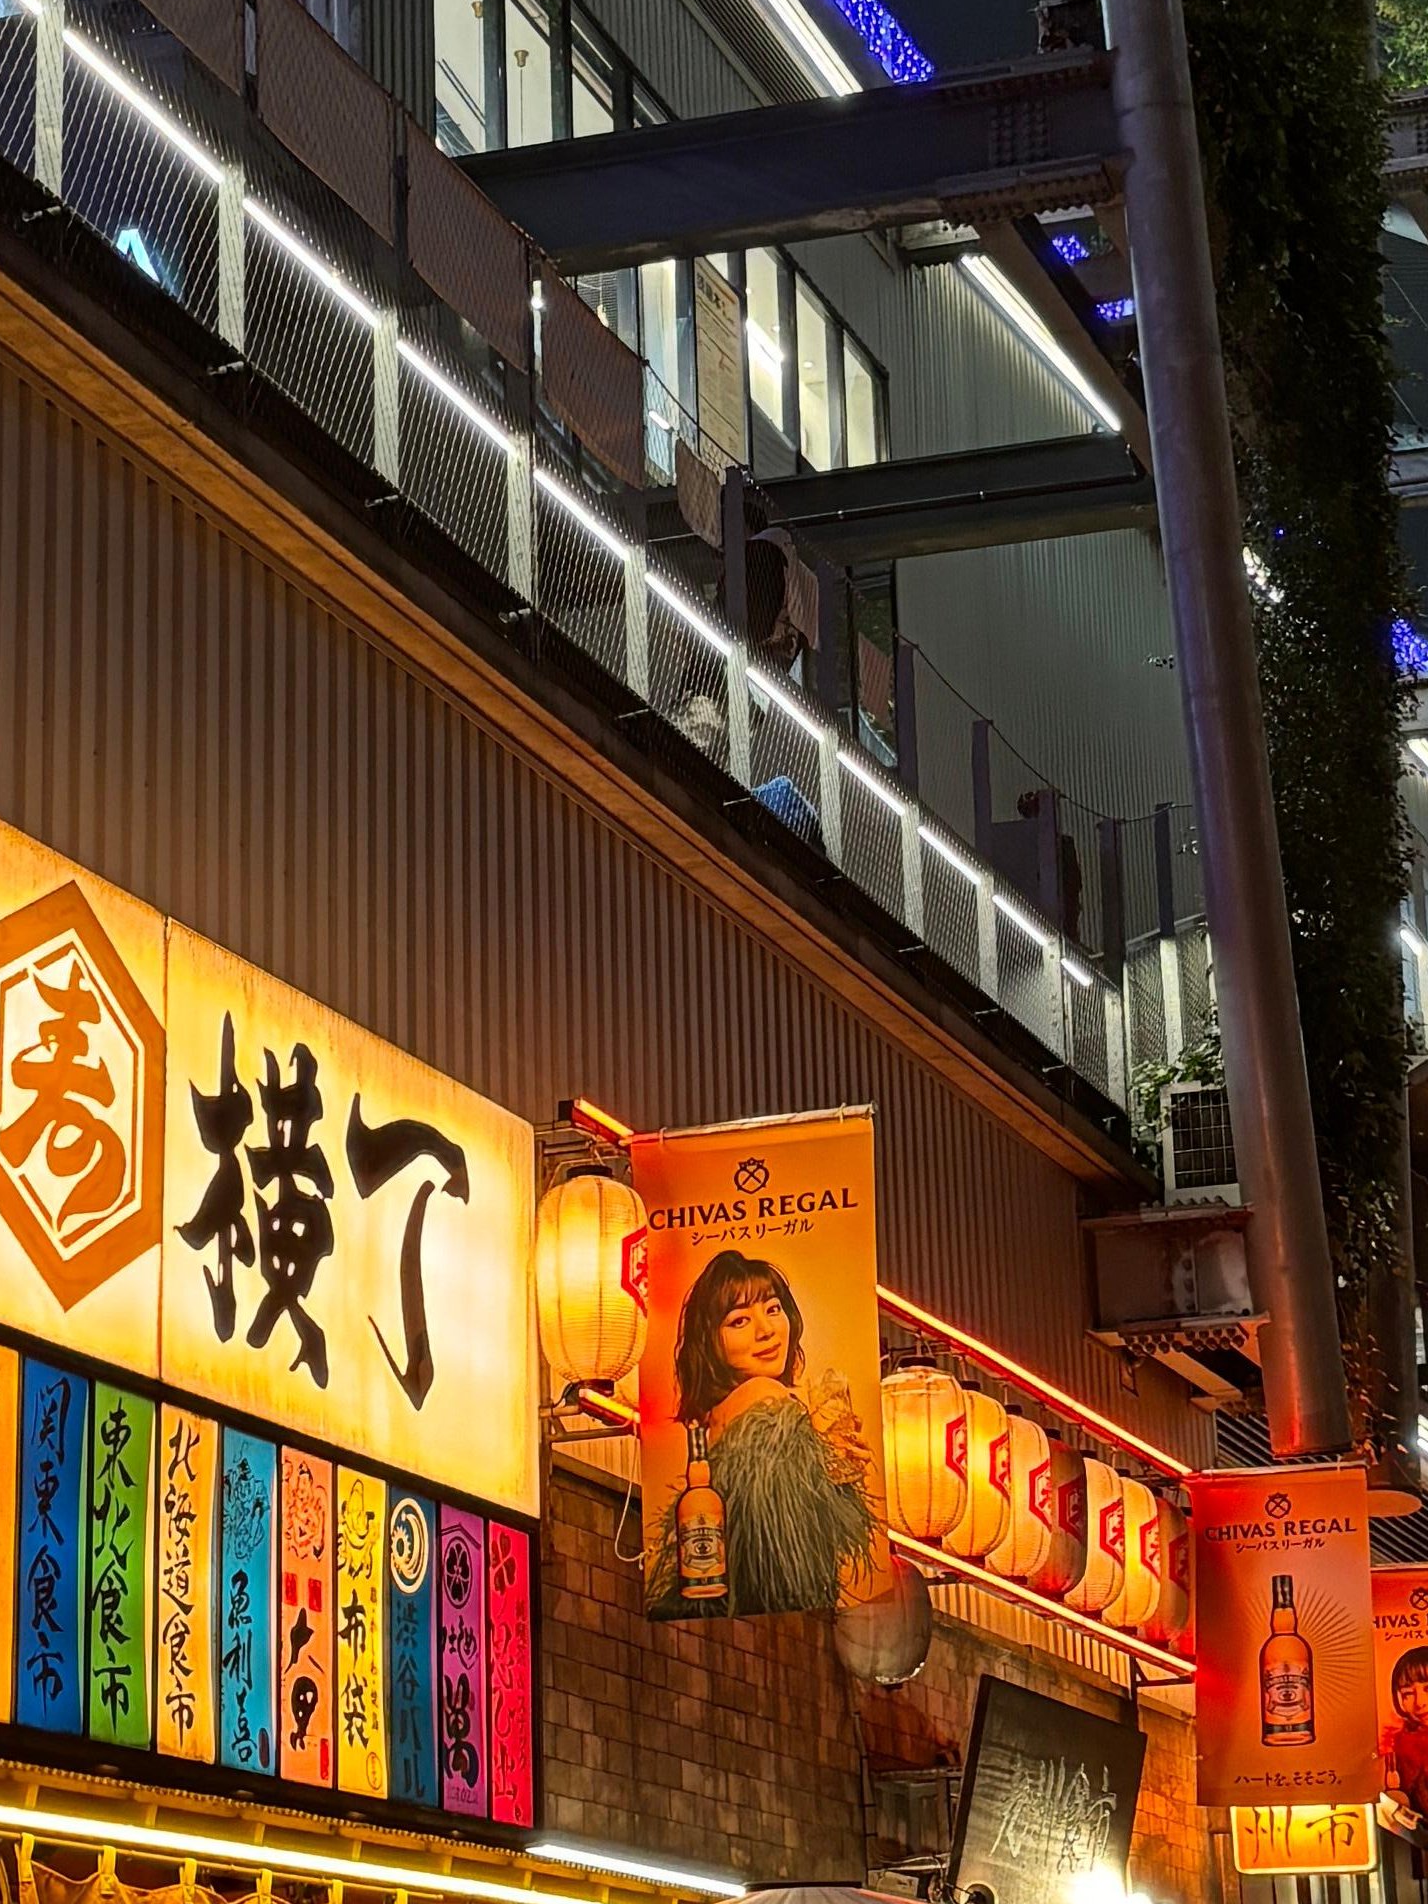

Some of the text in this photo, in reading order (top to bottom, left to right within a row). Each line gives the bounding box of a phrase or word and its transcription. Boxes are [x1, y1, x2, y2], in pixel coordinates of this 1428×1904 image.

[177, 1009, 471, 1411] 横丁
[649, 1187, 859, 1231] CHIVAS REGAL
[690, 1216, 815, 1247] シーバスリーガル
[25, 1376, 71, 1720] 関東食市
[91, 1397, 137, 1736] 東北食市
[1205, 1517, 1358, 1543] CHIVAS REGAL
[1235, 1537, 1326, 1554] シーバスリーガル
[161, 1416, 200, 1749] 北海道食市
[1373, 1612, 1419, 1630] HIVAS
[338, 1589, 371, 1750] 布袋
